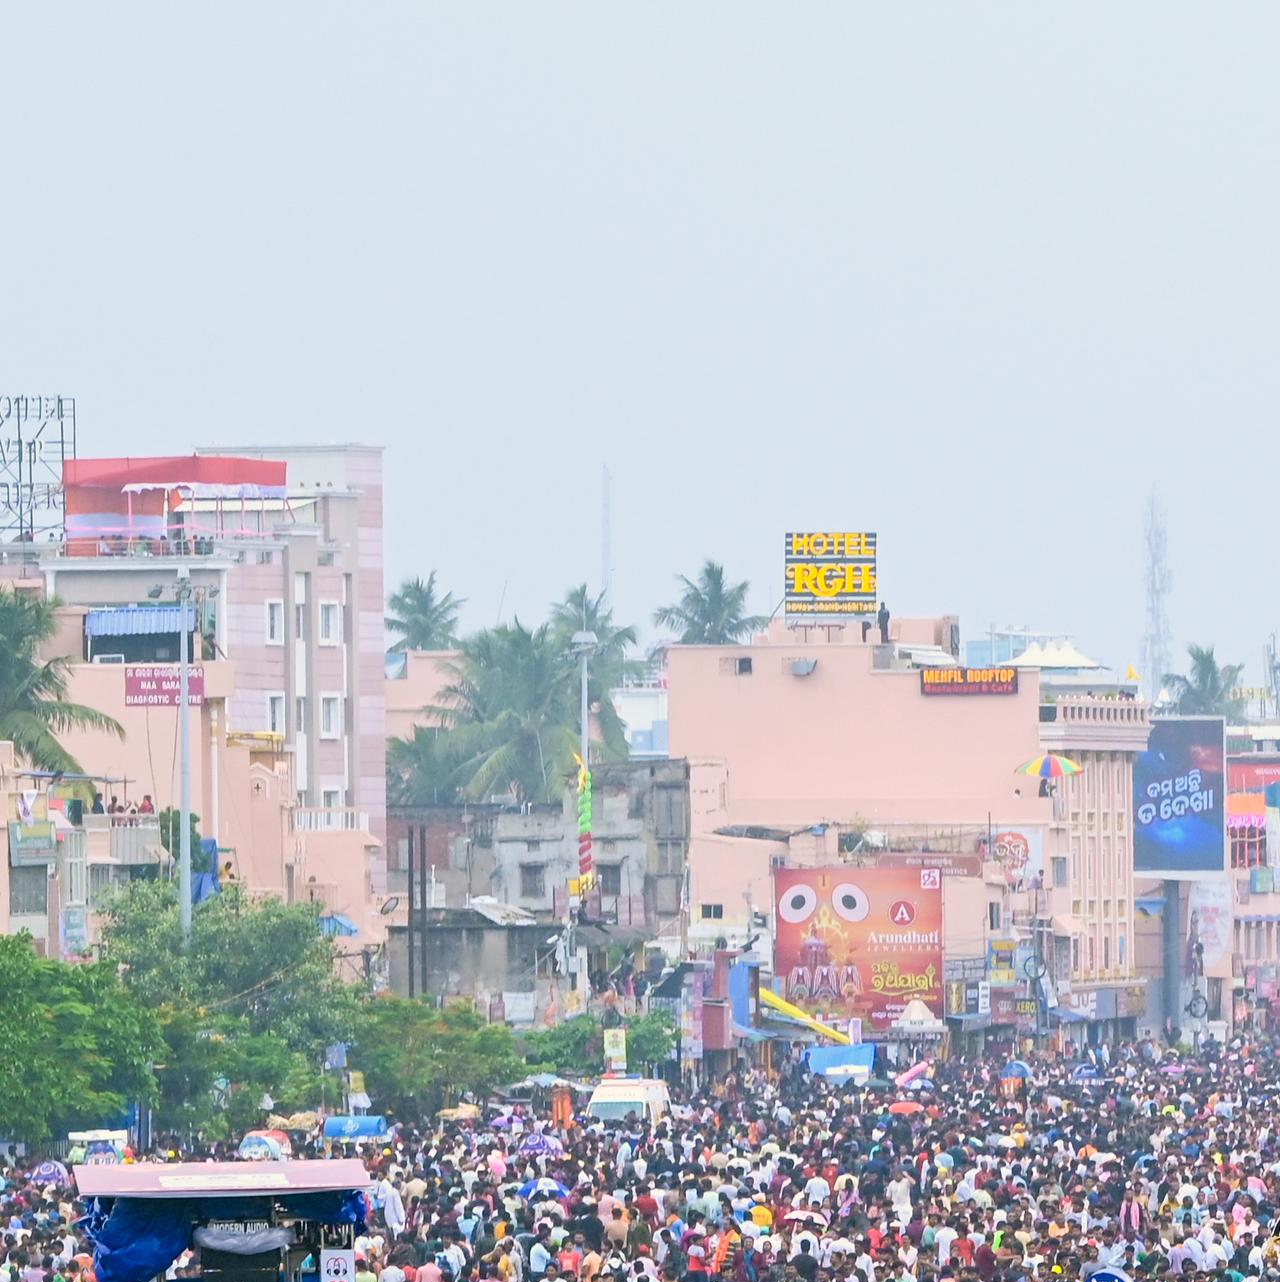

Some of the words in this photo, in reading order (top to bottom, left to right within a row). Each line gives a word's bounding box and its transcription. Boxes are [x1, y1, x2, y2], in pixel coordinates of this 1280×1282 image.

[792, 533, 875, 555] HOTEL
[786, 564, 877, 597] RGH
[923, 669, 964, 683] MEHFIL
[967, 669, 1015, 682] ROOFTOP
[141, 681, 157, 689] MAA
[126, 695, 169, 704] DIAGNOSTIC
[175, 695, 202, 704] CTRE
[867, 929, 939, 943] Arundhati
